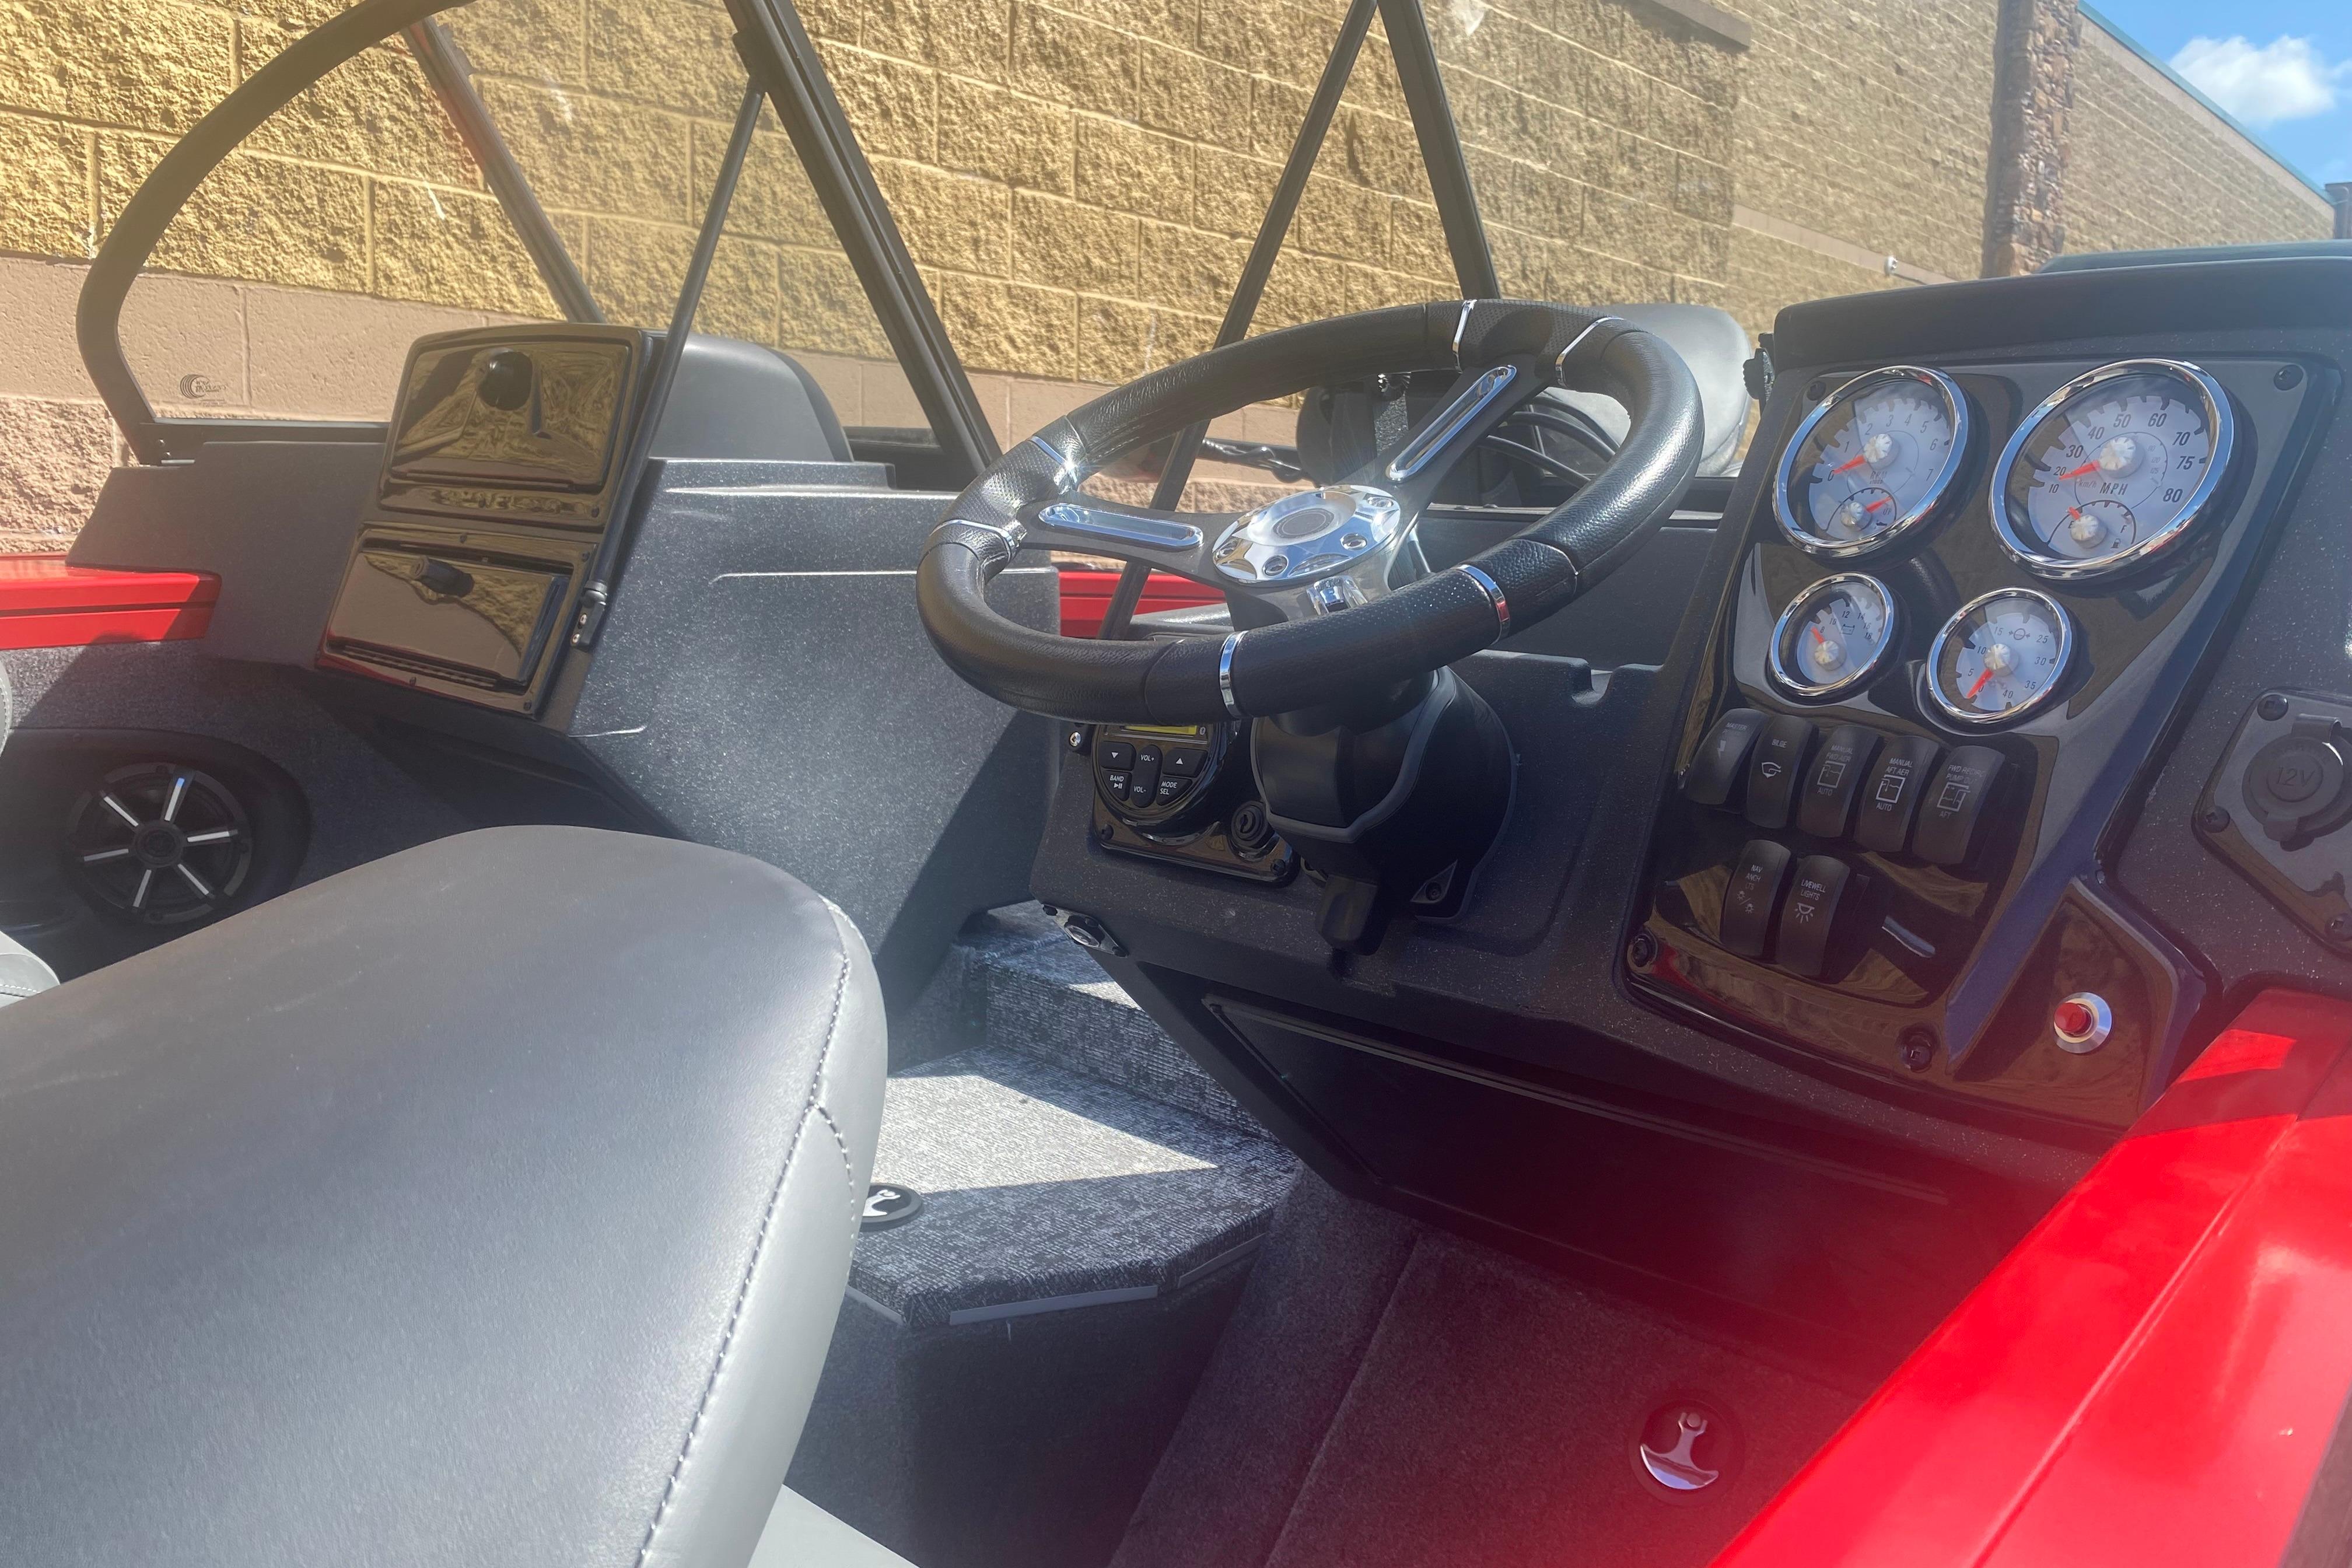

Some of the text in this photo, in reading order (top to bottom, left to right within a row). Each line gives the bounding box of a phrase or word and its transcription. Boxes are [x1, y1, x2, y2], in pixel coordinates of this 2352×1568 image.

[1886, 415, 1894, 427] 3
[1905, 414, 1912, 426] 4
[2113, 414, 2132, 428] 50
[2147, 413, 2167, 428] 60
[1866, 424, 1873, 435] 2
[1920, 421, 1929, 433] 5
[2088, 426, 2105, 440] 40
[1930, 439, 1937, 450] 6
[2172, 432, 2191, 446] 70
[2066, 444, 2084, 459] 30
[2176, 455, 2195, 470] 75
[1927, 468, 1934, 481] 7
[2053, 466, 2067, 477] 20
[2048, 484, 2059, 494] 10
[2099, 482, 2128, 495] MPH
[2163, 488, 2183, 503] 80
[2120, 524, 2127, 533] F
[1995, 626, 2003, 636] 15
[2036, 635, 2048, 644] 25
[1978, 646, 1986, 655] 10
[2035, 657, 2046, 666] 30
[1967, 668, 1975, 677] 5
[2025, 681, 2036, 690] 35
[2002, 690, 2014, 699] 40
[1726, 722, 1748, 730] MASTER
[1772, 739, 1787, 748] BILGE
[1831, 744, 1853, 754] MANUAL
[1889, 757, 1913, 768] MANUAL
[1948, 765, 1961, 773] FWD
[2277, 766, 2316, 787] 12V
[1817, 788, 1833, 796] AUTO
[1876, 803, 1892, 811] AUTO
[1751, 864, 1763, 873] NAV
[1746, 873, 1760, 882] ANCH
[1801, 879, 1826, 892] LIVEWELL
[1801, 889, 1820, 900] LIGHTS
